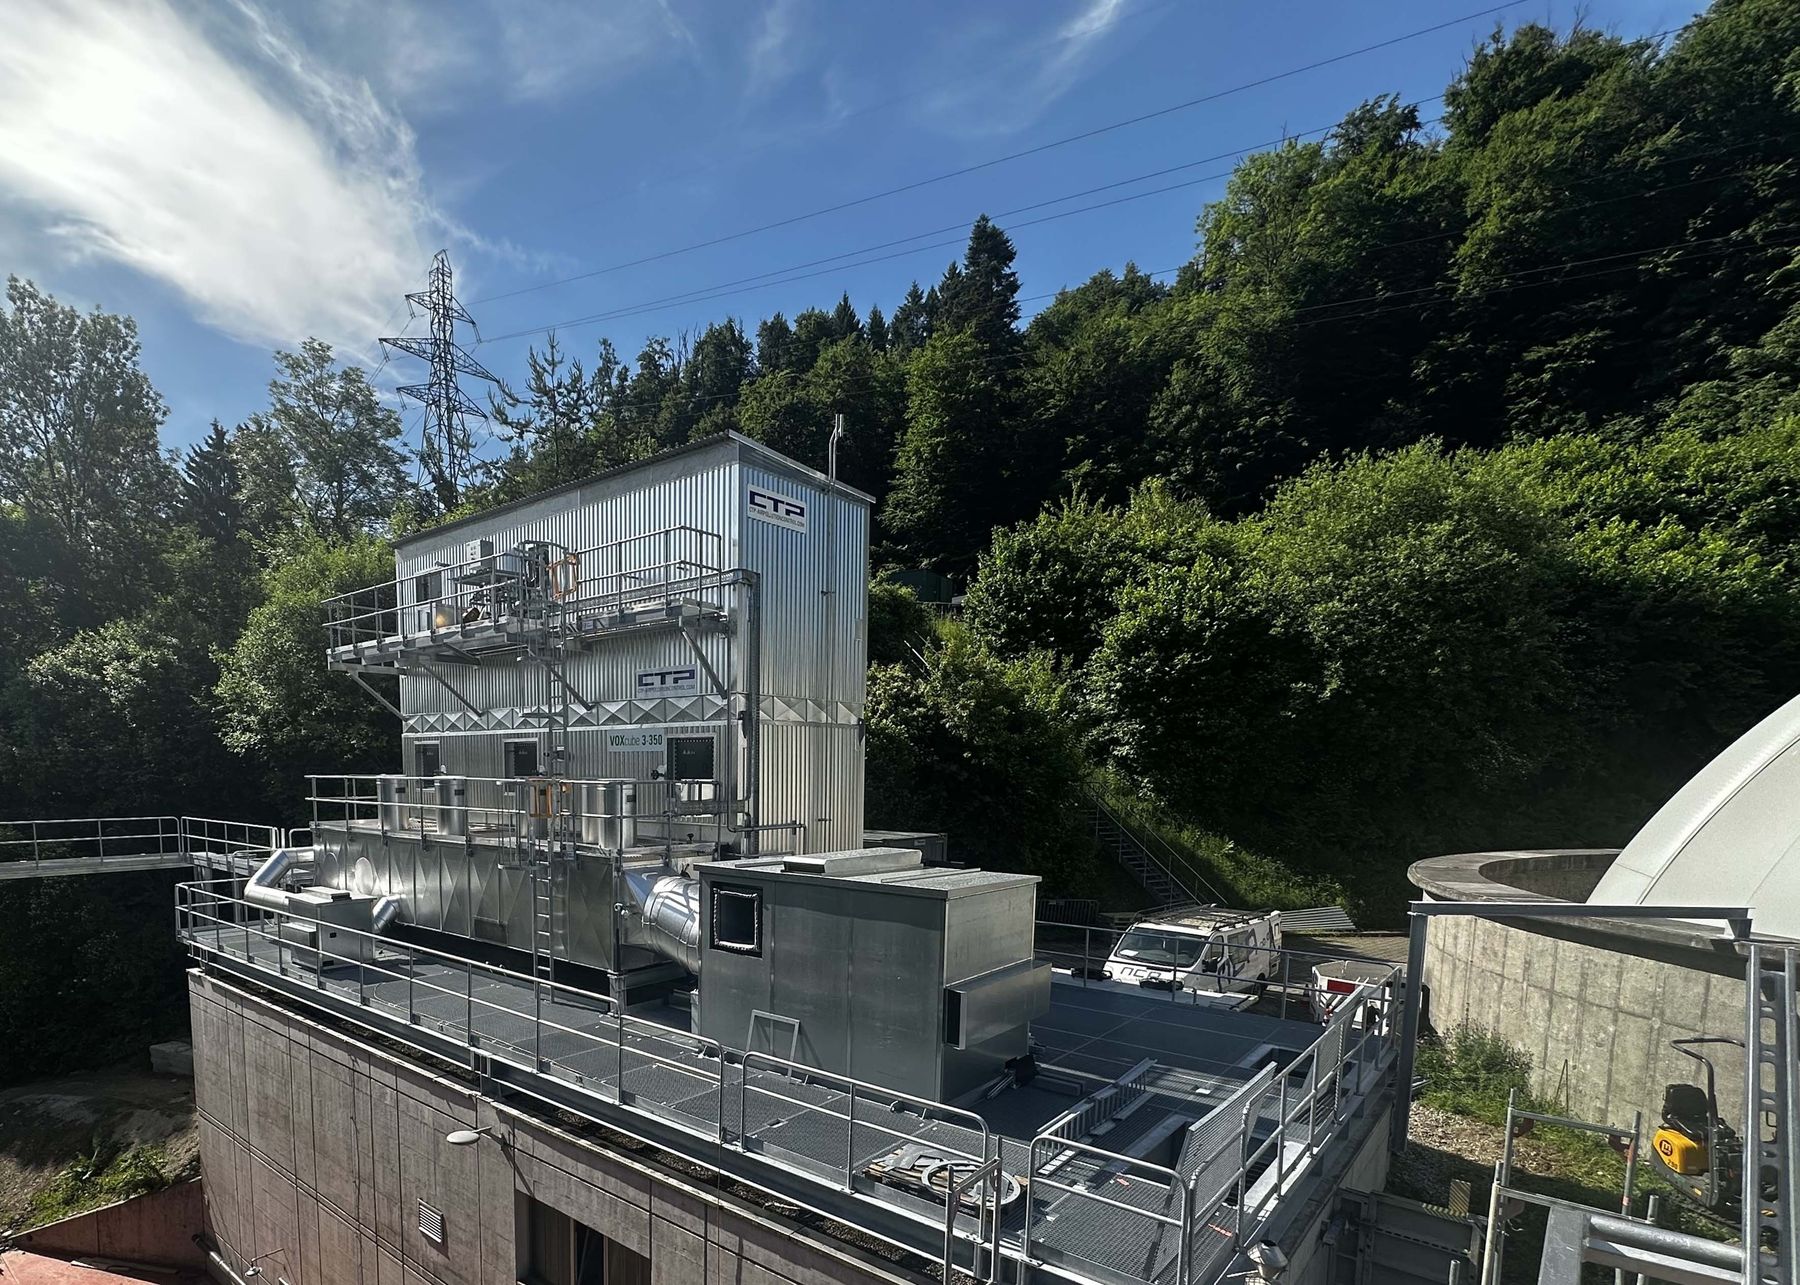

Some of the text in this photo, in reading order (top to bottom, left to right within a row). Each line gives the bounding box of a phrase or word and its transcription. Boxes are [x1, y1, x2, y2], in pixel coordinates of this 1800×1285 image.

[749, 490, 805, 518] CTP
[638, 669, 695, 687] CTP
[610, 735, 640, 746] VOXcube
